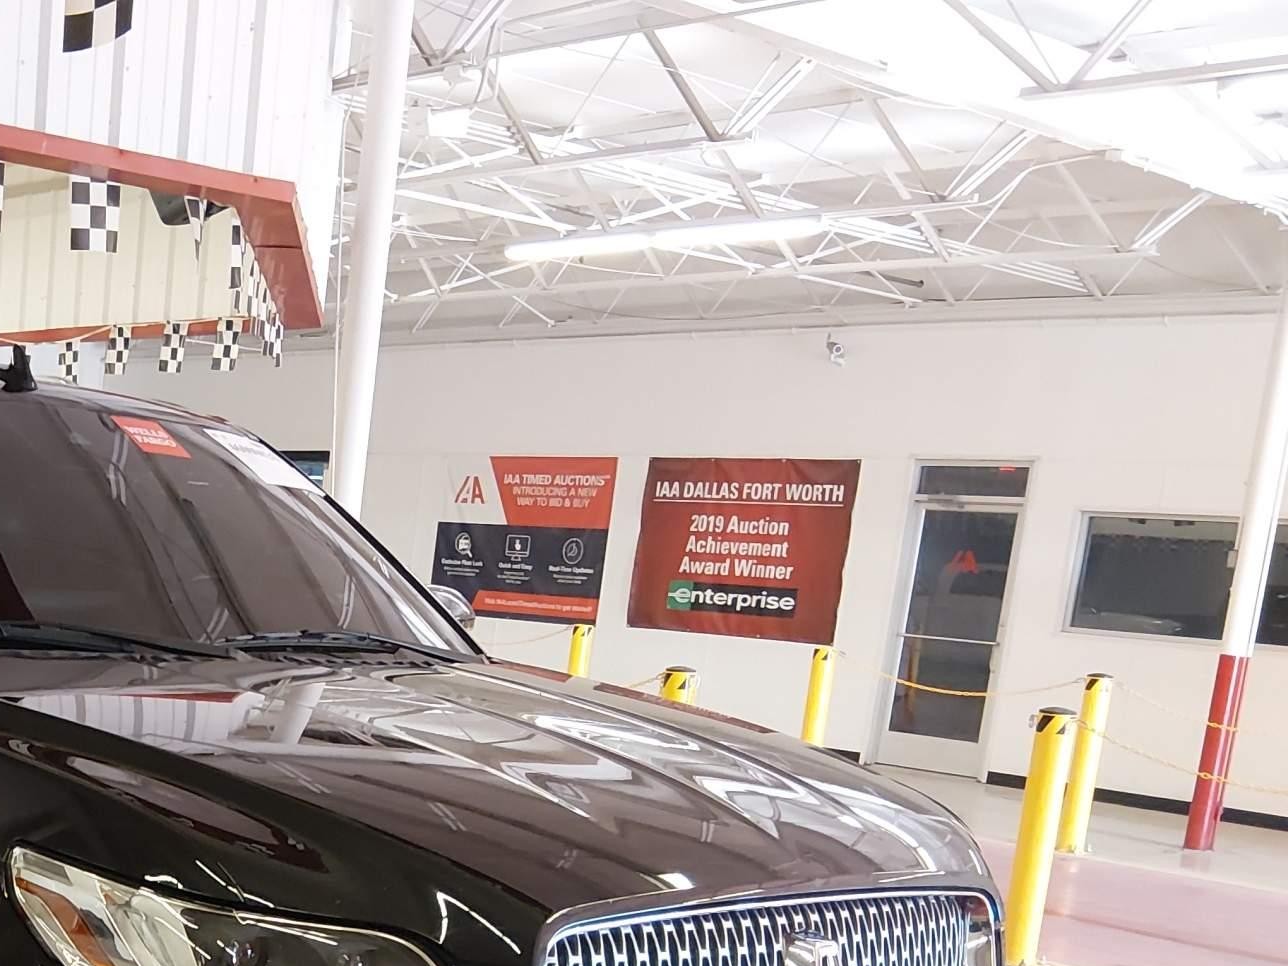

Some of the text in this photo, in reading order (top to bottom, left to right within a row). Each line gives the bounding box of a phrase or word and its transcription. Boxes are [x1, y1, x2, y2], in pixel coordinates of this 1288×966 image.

[503, 474, 520, 485] IAA
[522, 474, 552, 485] TIMED
[512, 486, 598, 498] INTRODUCING A NEW
[655, 480, 844, 503] IAA DALLAS FORT WORTH
[516, 497, 536, 507] WAY
[536, 497, 548, 507] TO
[548, 498, 563, 508] BID
[572, 498, 591, 509] BUY
[689, 514, 790, 536] 2019 Auction
[685, 535, 789, 558] Achievement
[679, 556, 794, 580] Award Winner
[668, 587, 796, 611] enterprise
